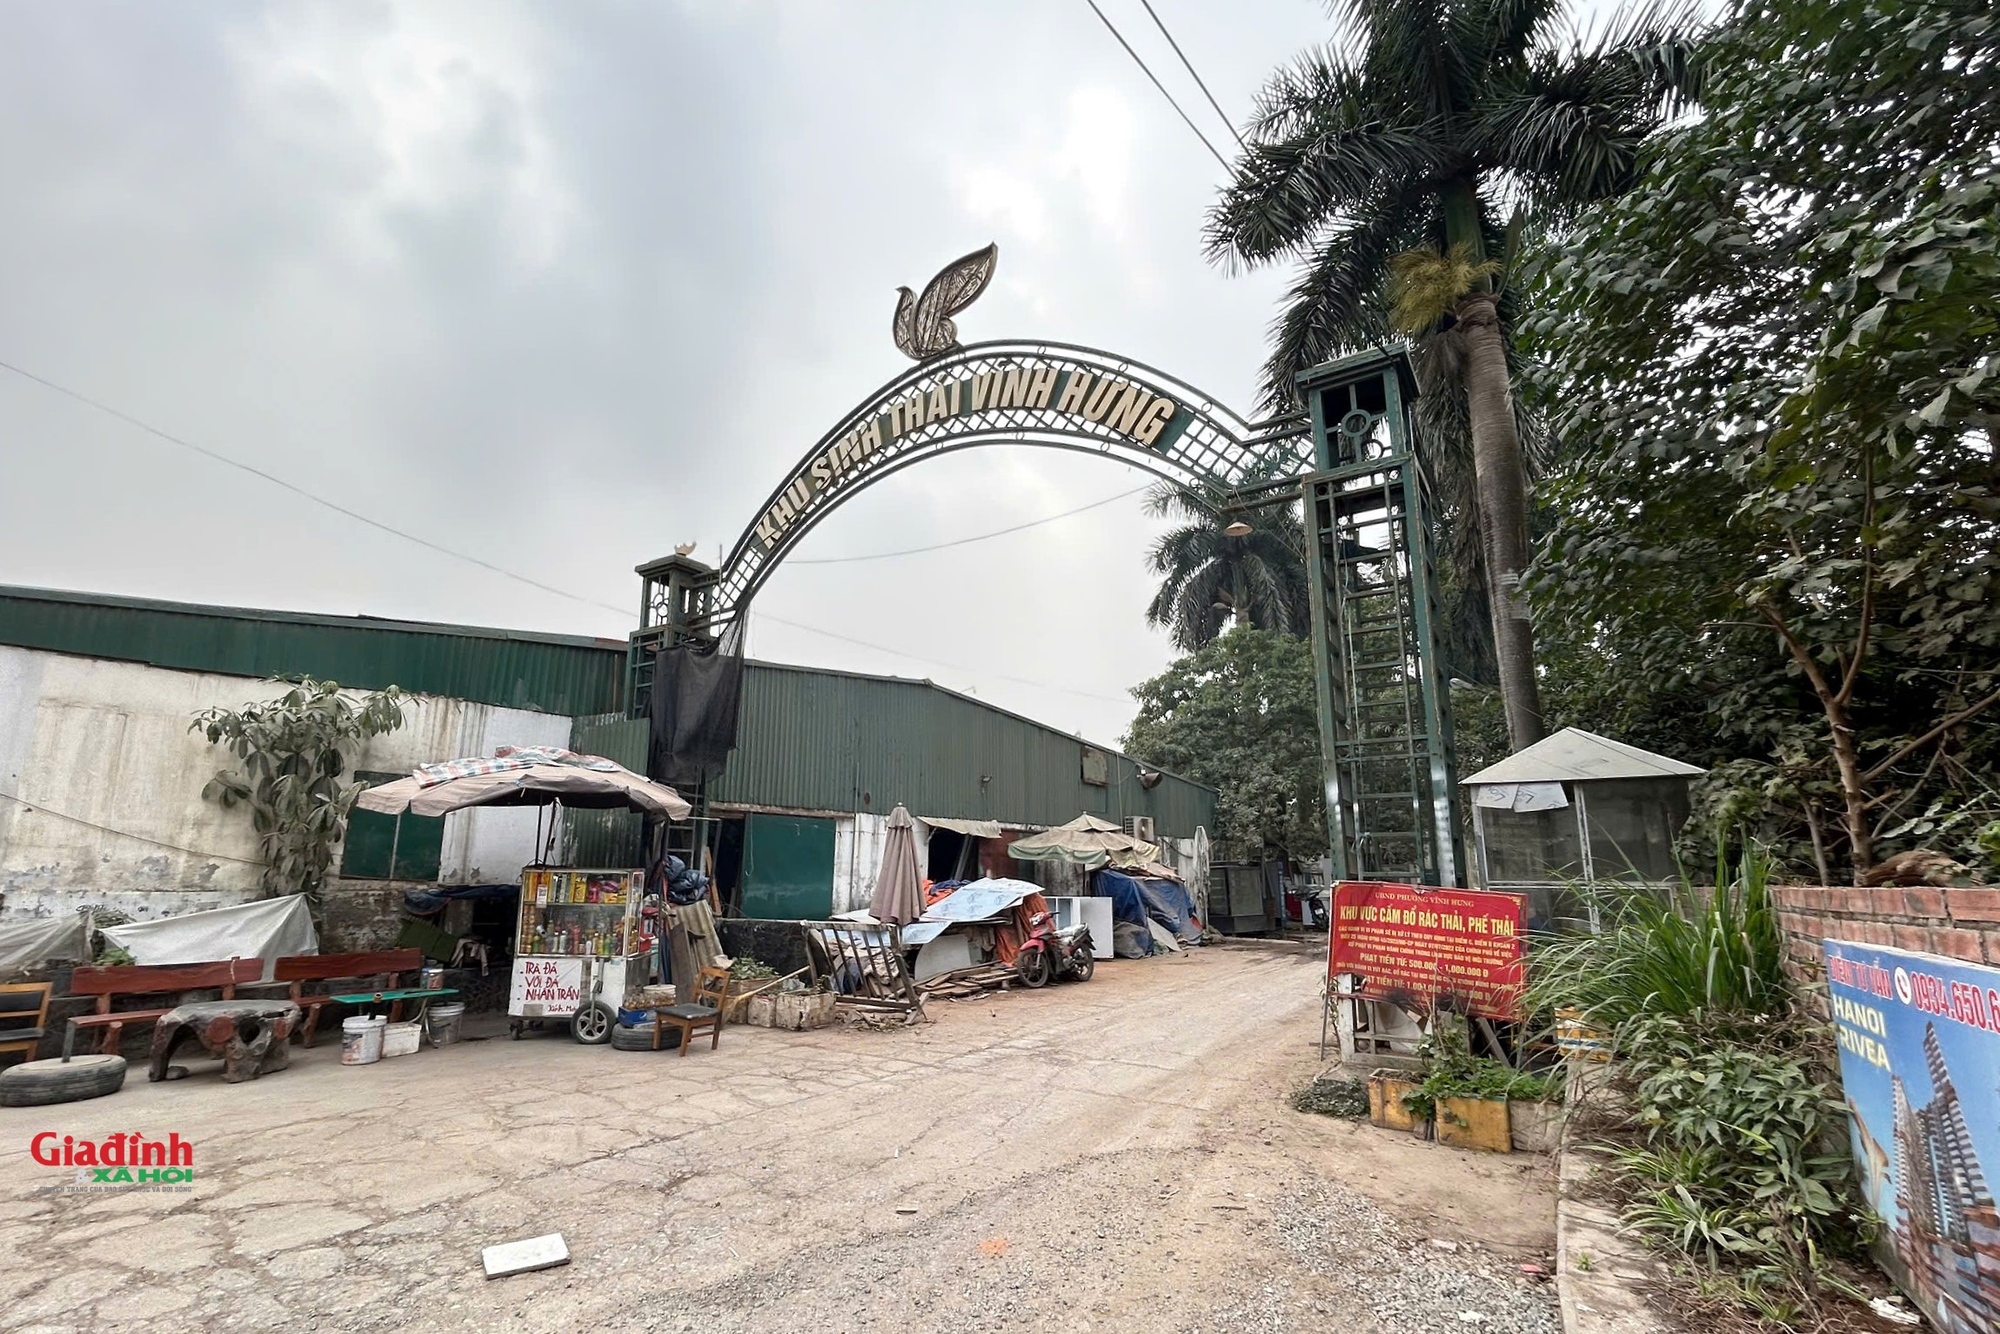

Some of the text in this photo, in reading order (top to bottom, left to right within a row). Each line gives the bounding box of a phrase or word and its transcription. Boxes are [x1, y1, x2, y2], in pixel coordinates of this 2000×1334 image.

[755, 477, 811, 550] KHU
[810, 419, 882, 490] SINH
[887, 375, 960, 437] THÁI
[1056, 370, 1175, 447] HƯNG
[1340, 903, 1514, 936] KHU VỰC CẤM ĐỔ RÁC THẢI, PHẾ THẢI
[543, 961, 557, 974] ĐÁ
[1359, 952, 1377, 963] PHẠT
[545, 975, 559, 988] ĐÁ
[1832, 993, 1887, 1039] HANOI
[1839, 1024, 1892, 1072] RIVEA
